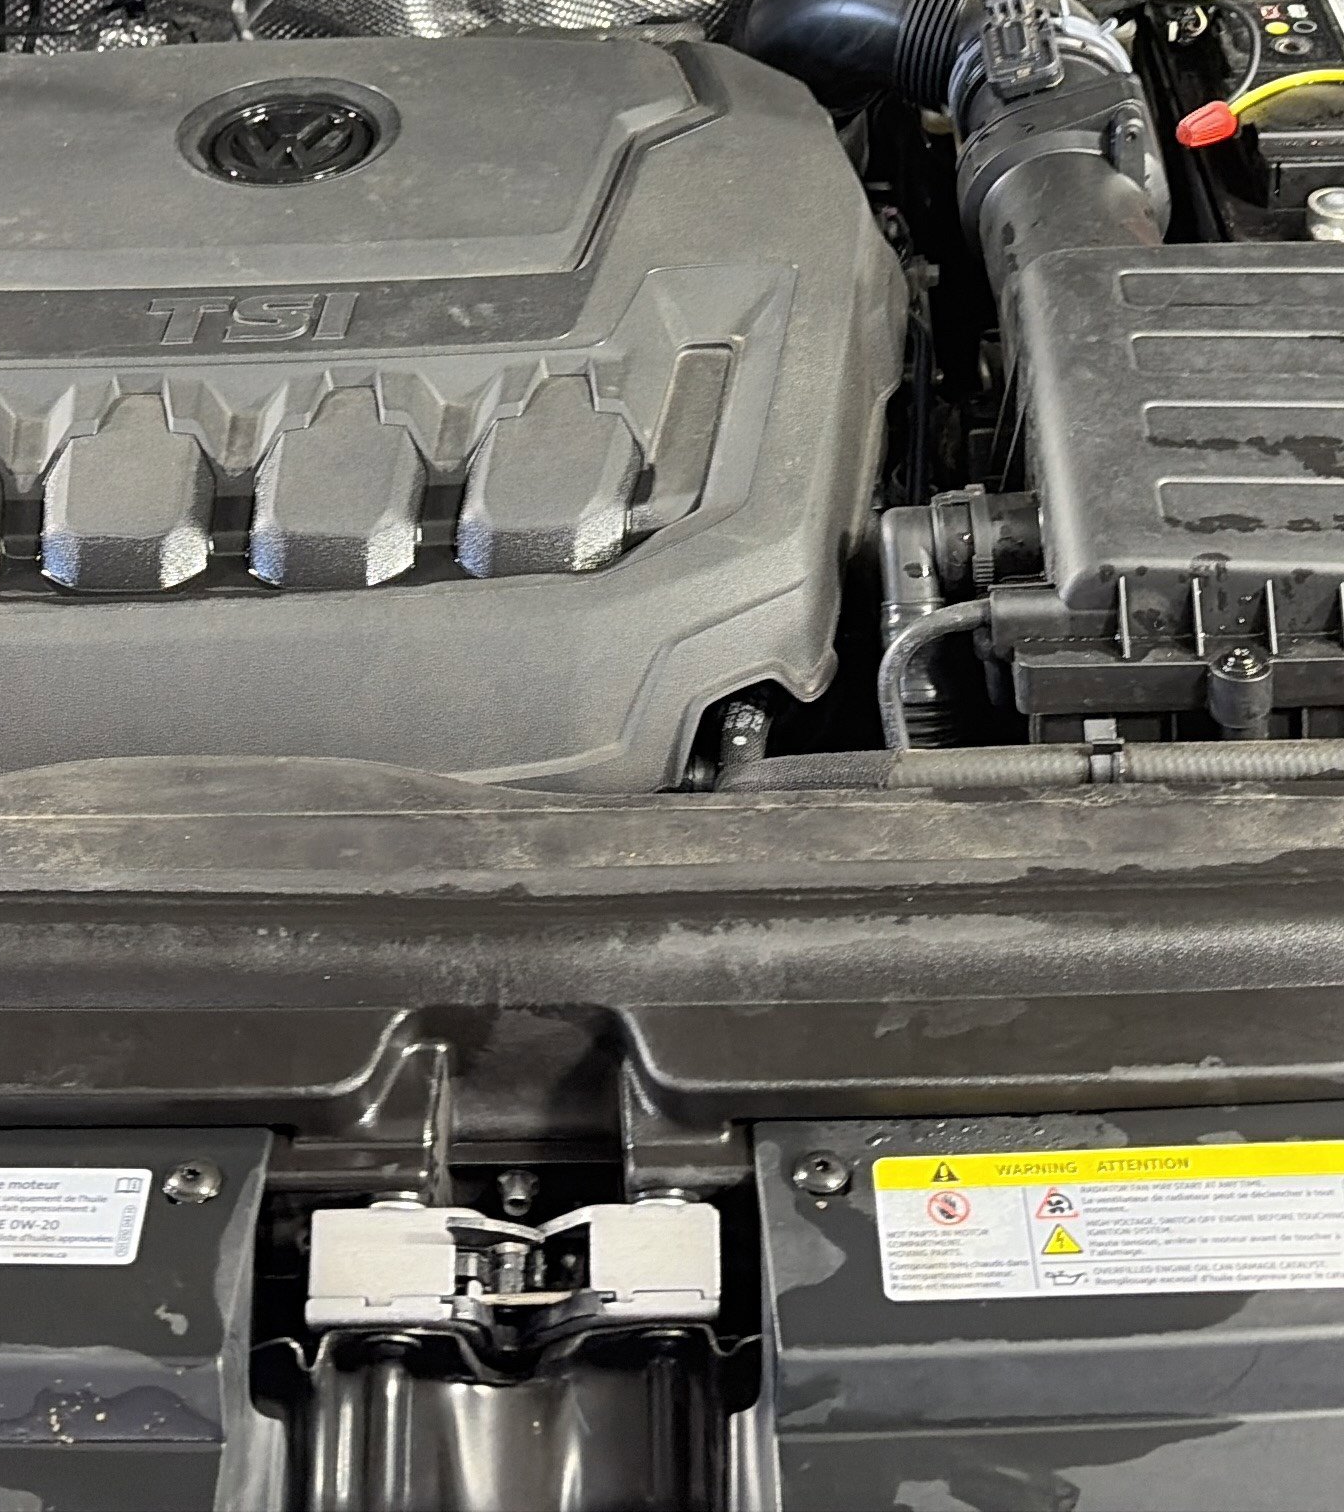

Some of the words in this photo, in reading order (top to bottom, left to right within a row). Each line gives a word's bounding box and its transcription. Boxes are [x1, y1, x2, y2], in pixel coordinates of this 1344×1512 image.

[146, 292, 360, 346] TSI
[996, 1161, 1077, 1176] WARNING
[1097, 1157, 1189, 1172] ATTENTION
[9, 1179, 60, 1189] moteur
[10, 1219, 60, 1230] 0W-20
